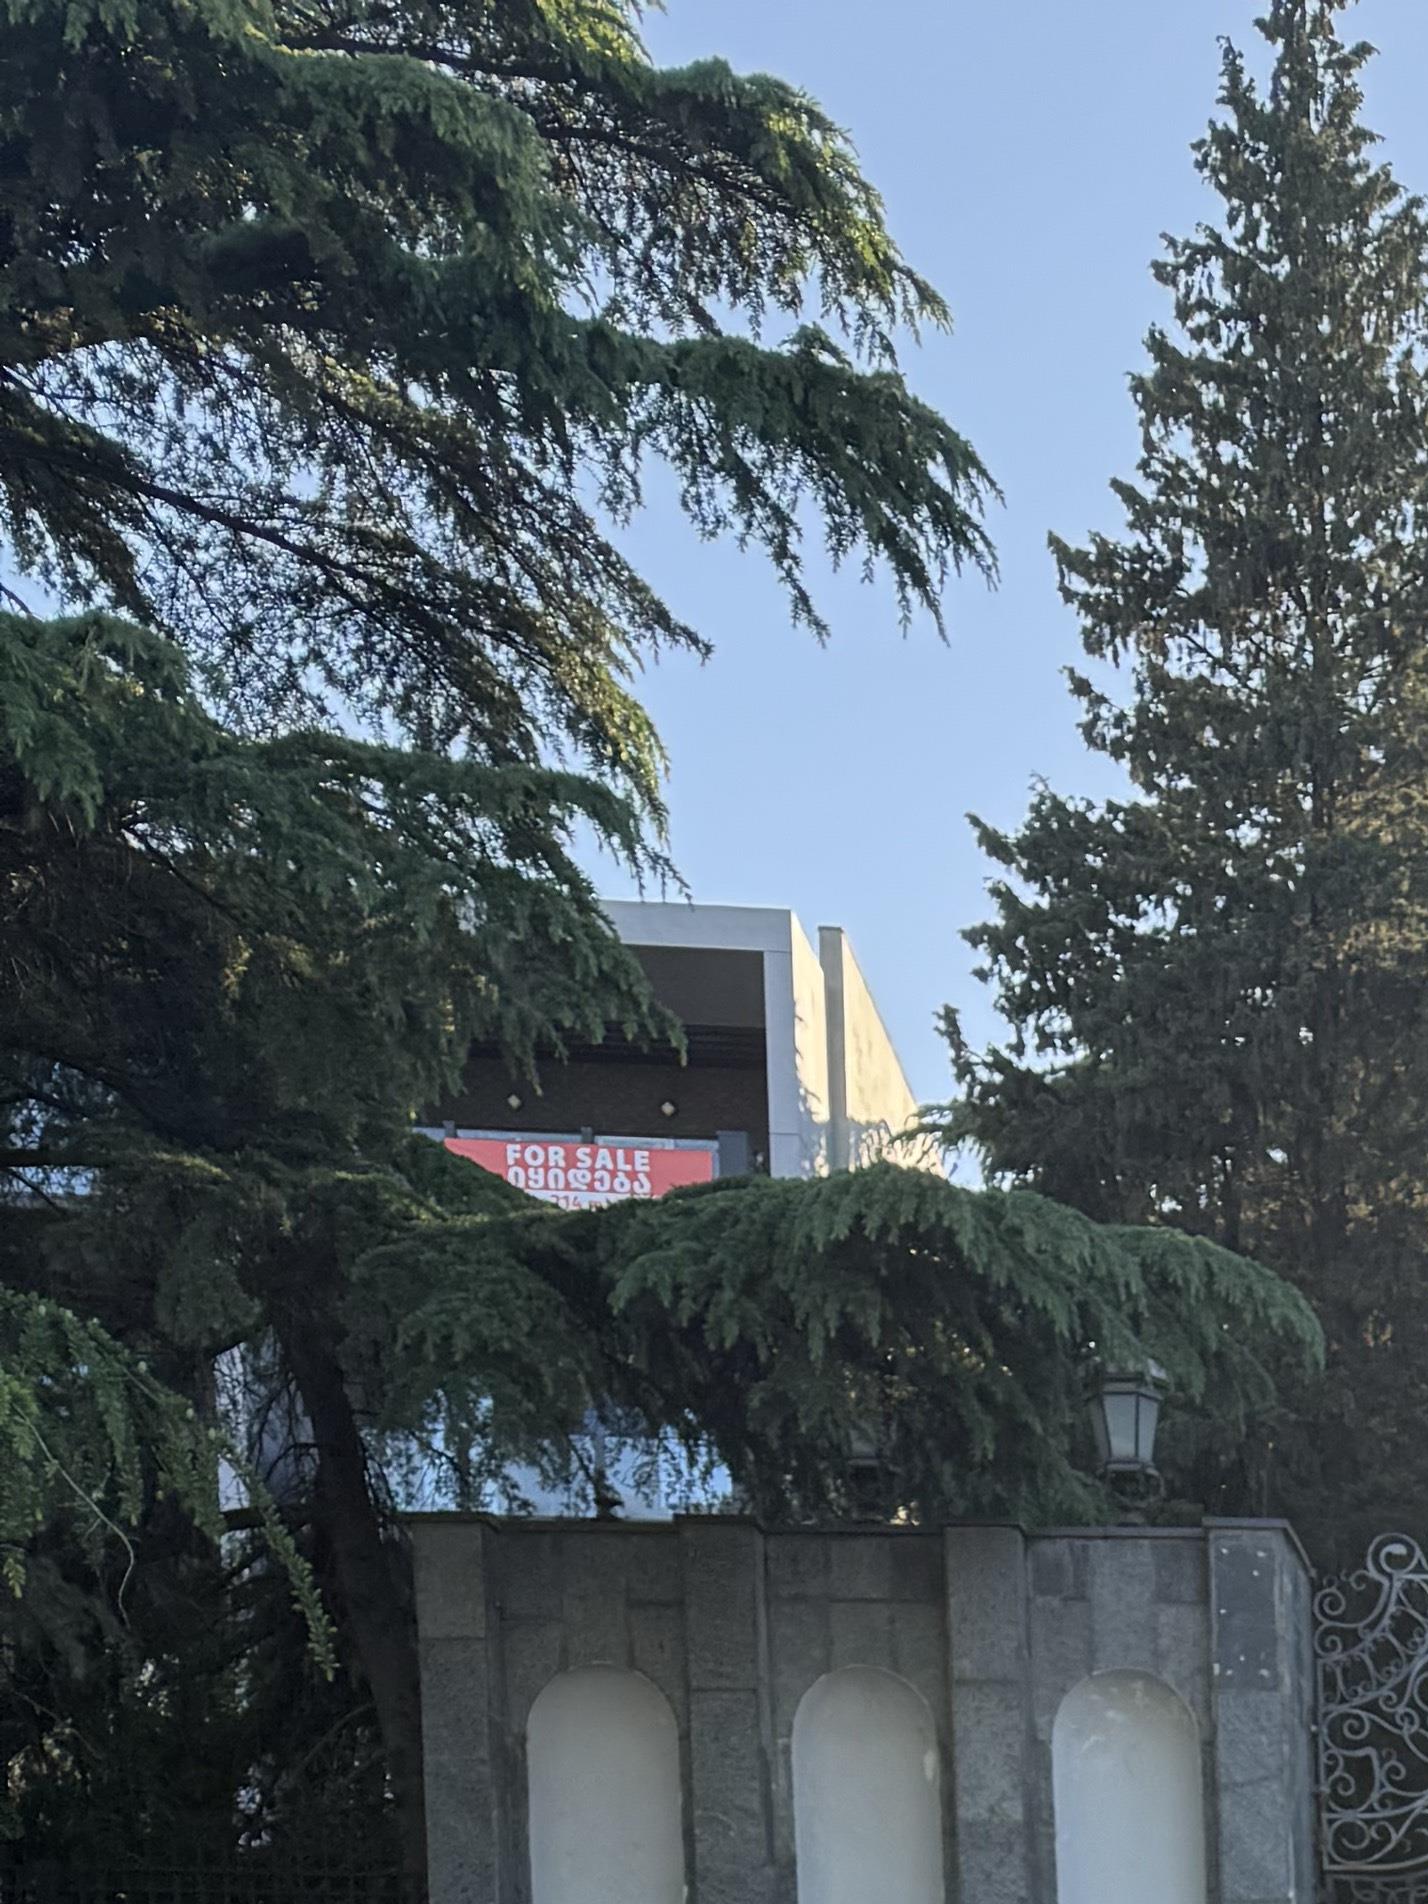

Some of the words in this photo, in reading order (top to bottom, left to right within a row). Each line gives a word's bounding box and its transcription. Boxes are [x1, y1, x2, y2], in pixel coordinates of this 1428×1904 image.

[506, 1144, 566, 1167] FOR
[576, 1147, 650, 1172] SALE
[507, 1166, 652, 1195] იყიდება
